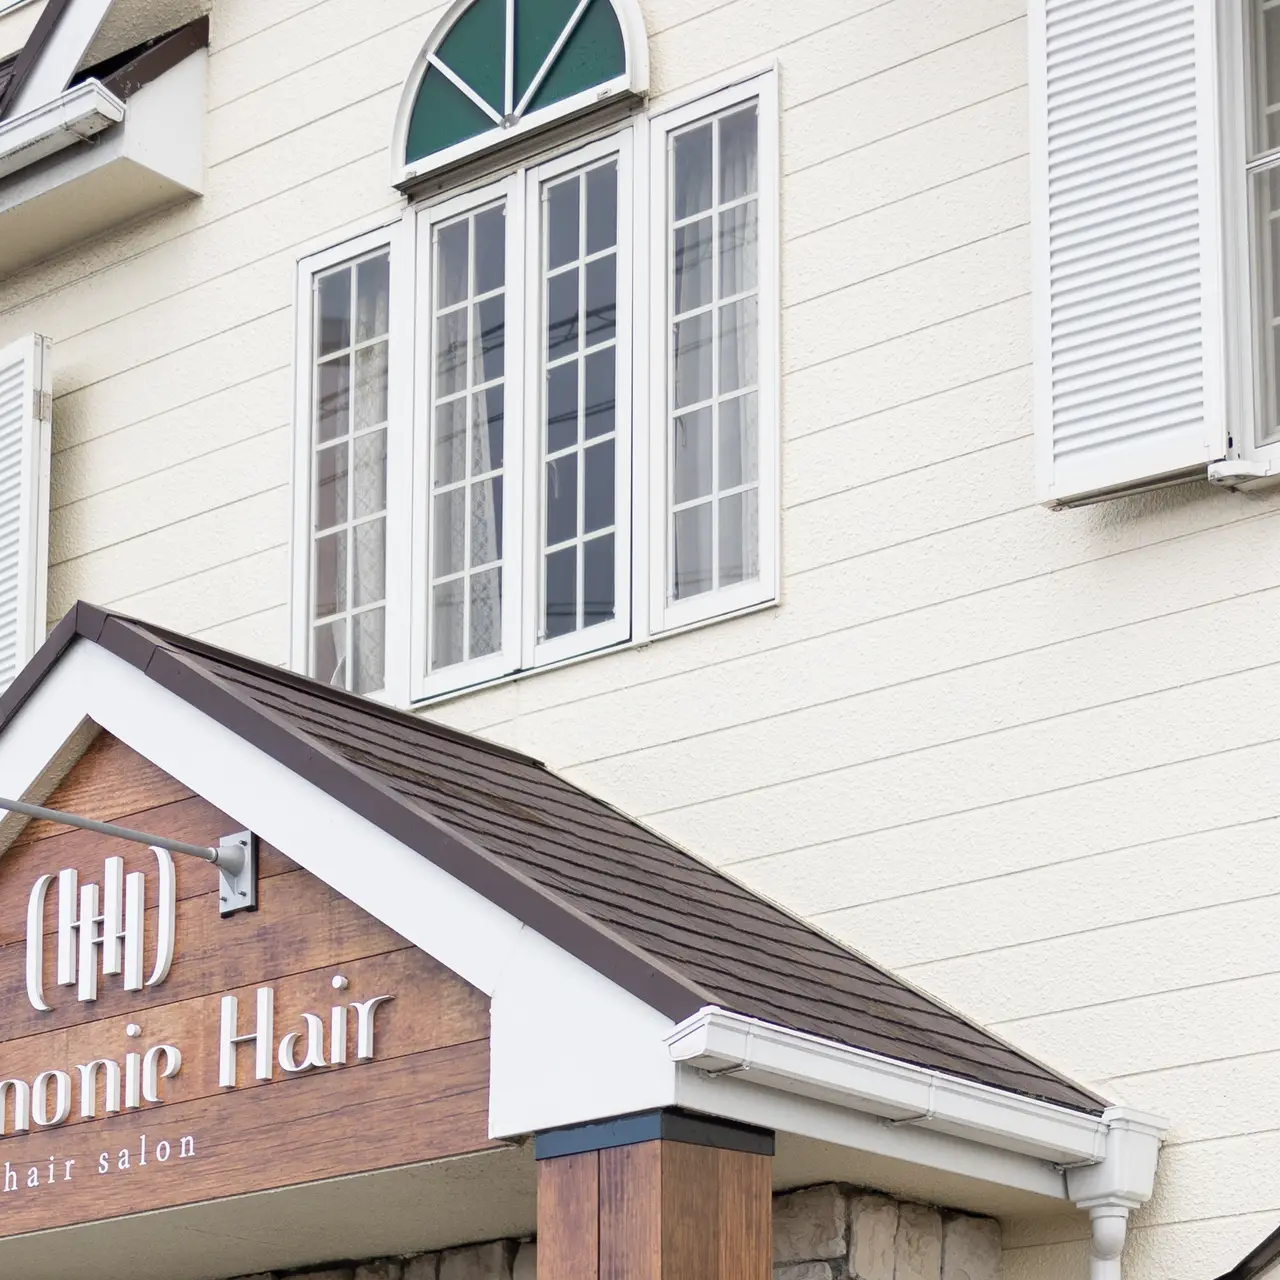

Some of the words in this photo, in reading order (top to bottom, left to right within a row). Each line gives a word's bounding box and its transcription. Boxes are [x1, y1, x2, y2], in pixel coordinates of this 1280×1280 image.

[219, 974, 395, 1088] Hair
[3, 1156, 76, 1193] hair
[97, 1134, 197, 1176] salon
